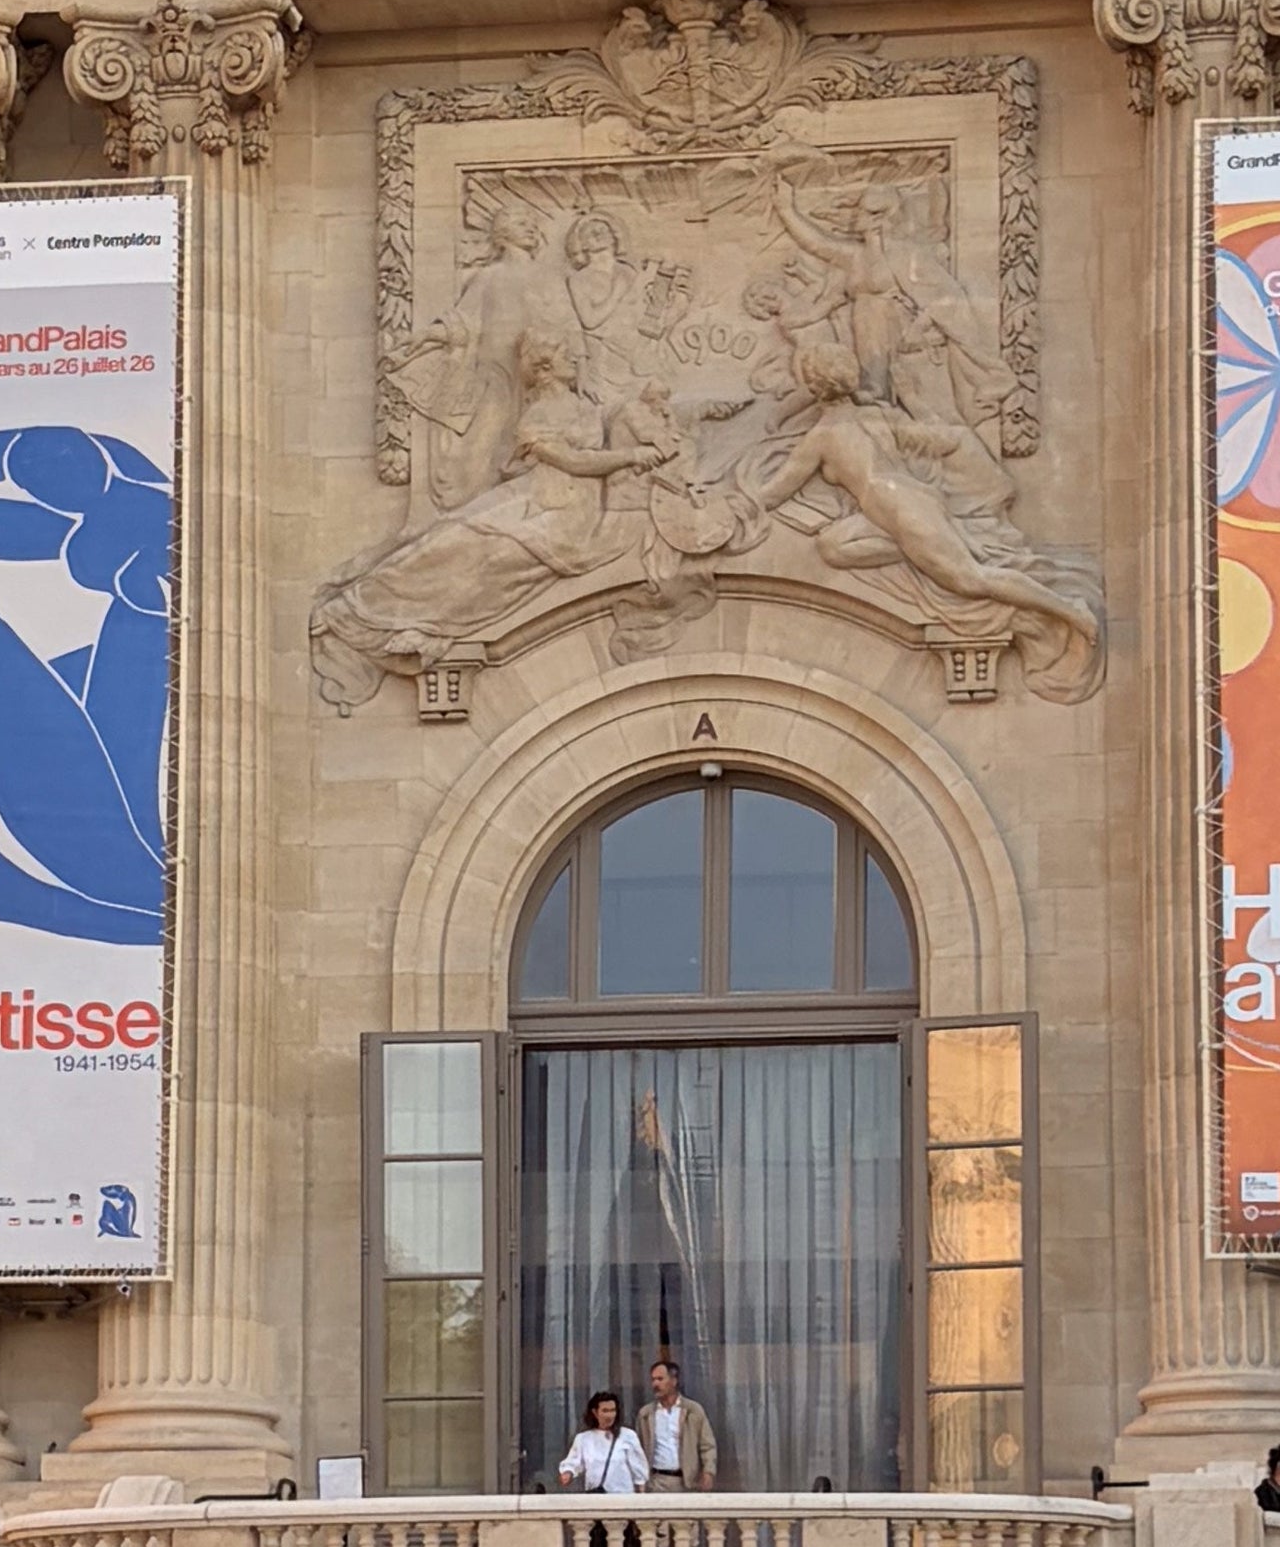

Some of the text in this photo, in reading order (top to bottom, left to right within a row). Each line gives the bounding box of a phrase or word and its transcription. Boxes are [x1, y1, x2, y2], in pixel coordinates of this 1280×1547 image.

[47, 236, 90, 250] Centre
[93, 232, 161, 249] Pompidou
[666, 321, 758, 366] 1900
[28, 361, 51, 376] au
[53, 357, 79, 375] 26
[80, 356, 127, 377] juillet
[130, 354, 156, 373] 26
[692, 712, 718, 741] A
[54, 1053, 157, 1072] 1941-1954
